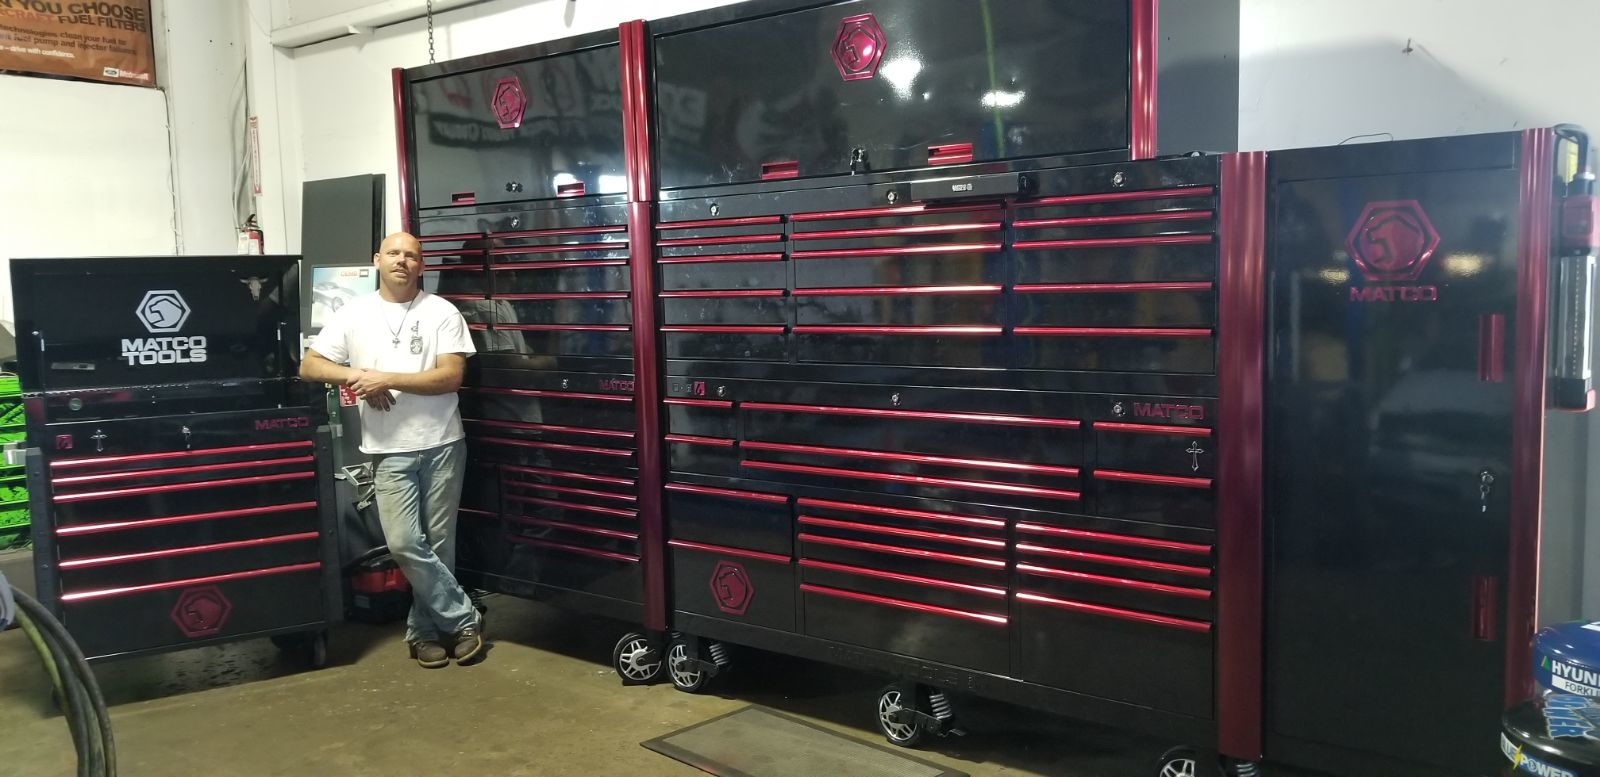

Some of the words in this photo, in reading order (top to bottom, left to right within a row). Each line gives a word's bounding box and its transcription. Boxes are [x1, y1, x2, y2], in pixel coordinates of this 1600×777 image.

[17, 0, 62, 14] YOU
[67, 1, 145, 22] CHOOSE
[58, 14, 96, 26] FUEL
[97, 16, 147, 33] FILTERS
[33, 37, 59, 46] pump
[60, 40, 76, 48] and
[60, 31, 82, 40] clean
[1349, 286, 1438, 302] MATCO
[121, 335, 207, 352] MATCO
[121, 349, 207, 366] TOOLS
[1133, 402, 1204, 420] MATCO
[254, 416, 310, 431] MATCO
[1552, 659, 1600, 688] HYUN
